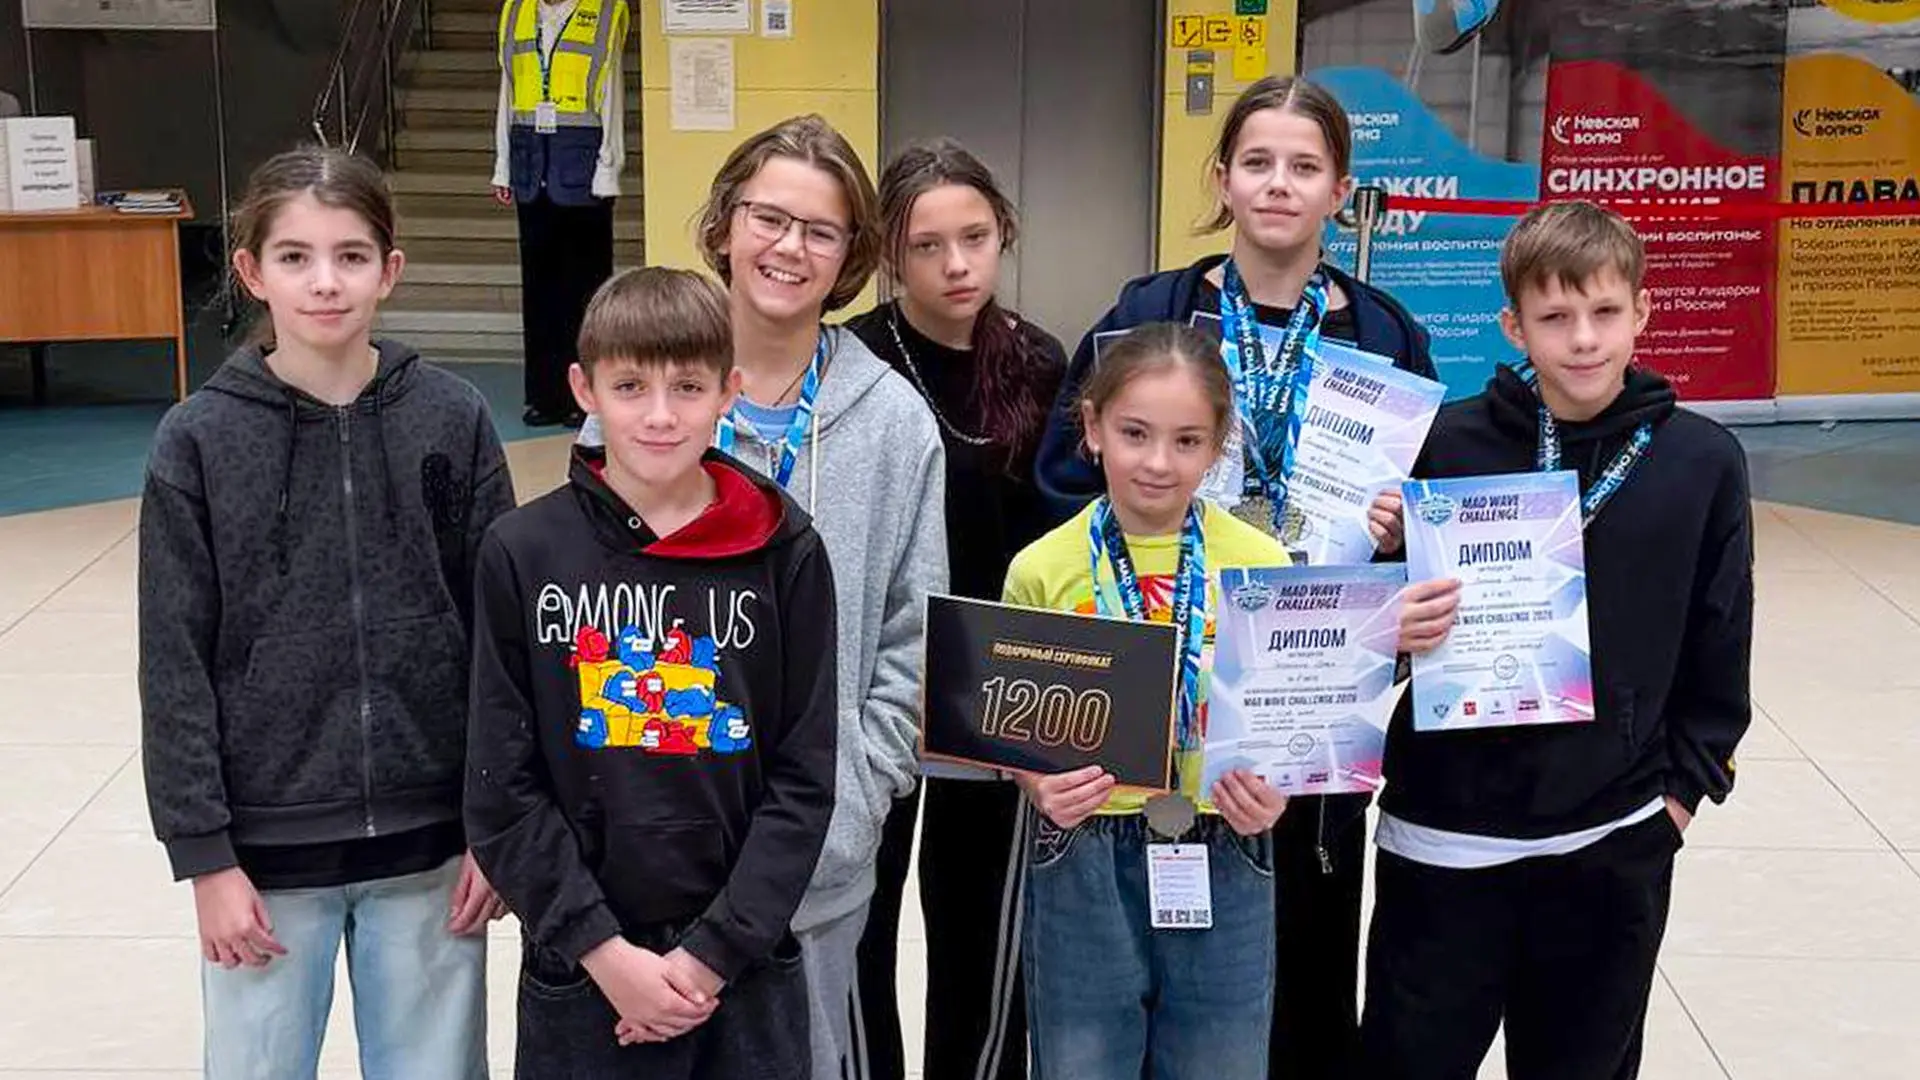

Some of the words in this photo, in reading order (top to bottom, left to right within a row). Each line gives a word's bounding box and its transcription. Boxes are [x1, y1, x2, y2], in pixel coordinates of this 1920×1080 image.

[1815, 107, 1881, 121] Невская
[1574, 116, 1639, 130] Невская
[1815, 124, 1863, 137] волна
[1574, 132, 1621, 144] волна
[1548, 165, 1766, 193] СИНХРОННОЕ
[1674, 300, 1728, 312] России
[1322, 377, 1378, 405] CHALLENGE
[1303, 405, 1375, 445] ДИПЛОМ
[1462, 496, 1488, 509] MAD
[1490, 494, 1519, 507] WAVE
[1459, 507, 1519, 523] CHALLENGE
[1458, 540, 1532, 567] ДИПЛОМ
[1280, 584, 1309, 597] MAD
[1310, 583, 1344, 596] WAVE
[1275, 598, 1339, 611] CHALLENGE
[708, 588, 758, 649] US
[1268, 628, 1347, 652] ДИПЛОМ
[981, 676, 1112, 752] 1200
